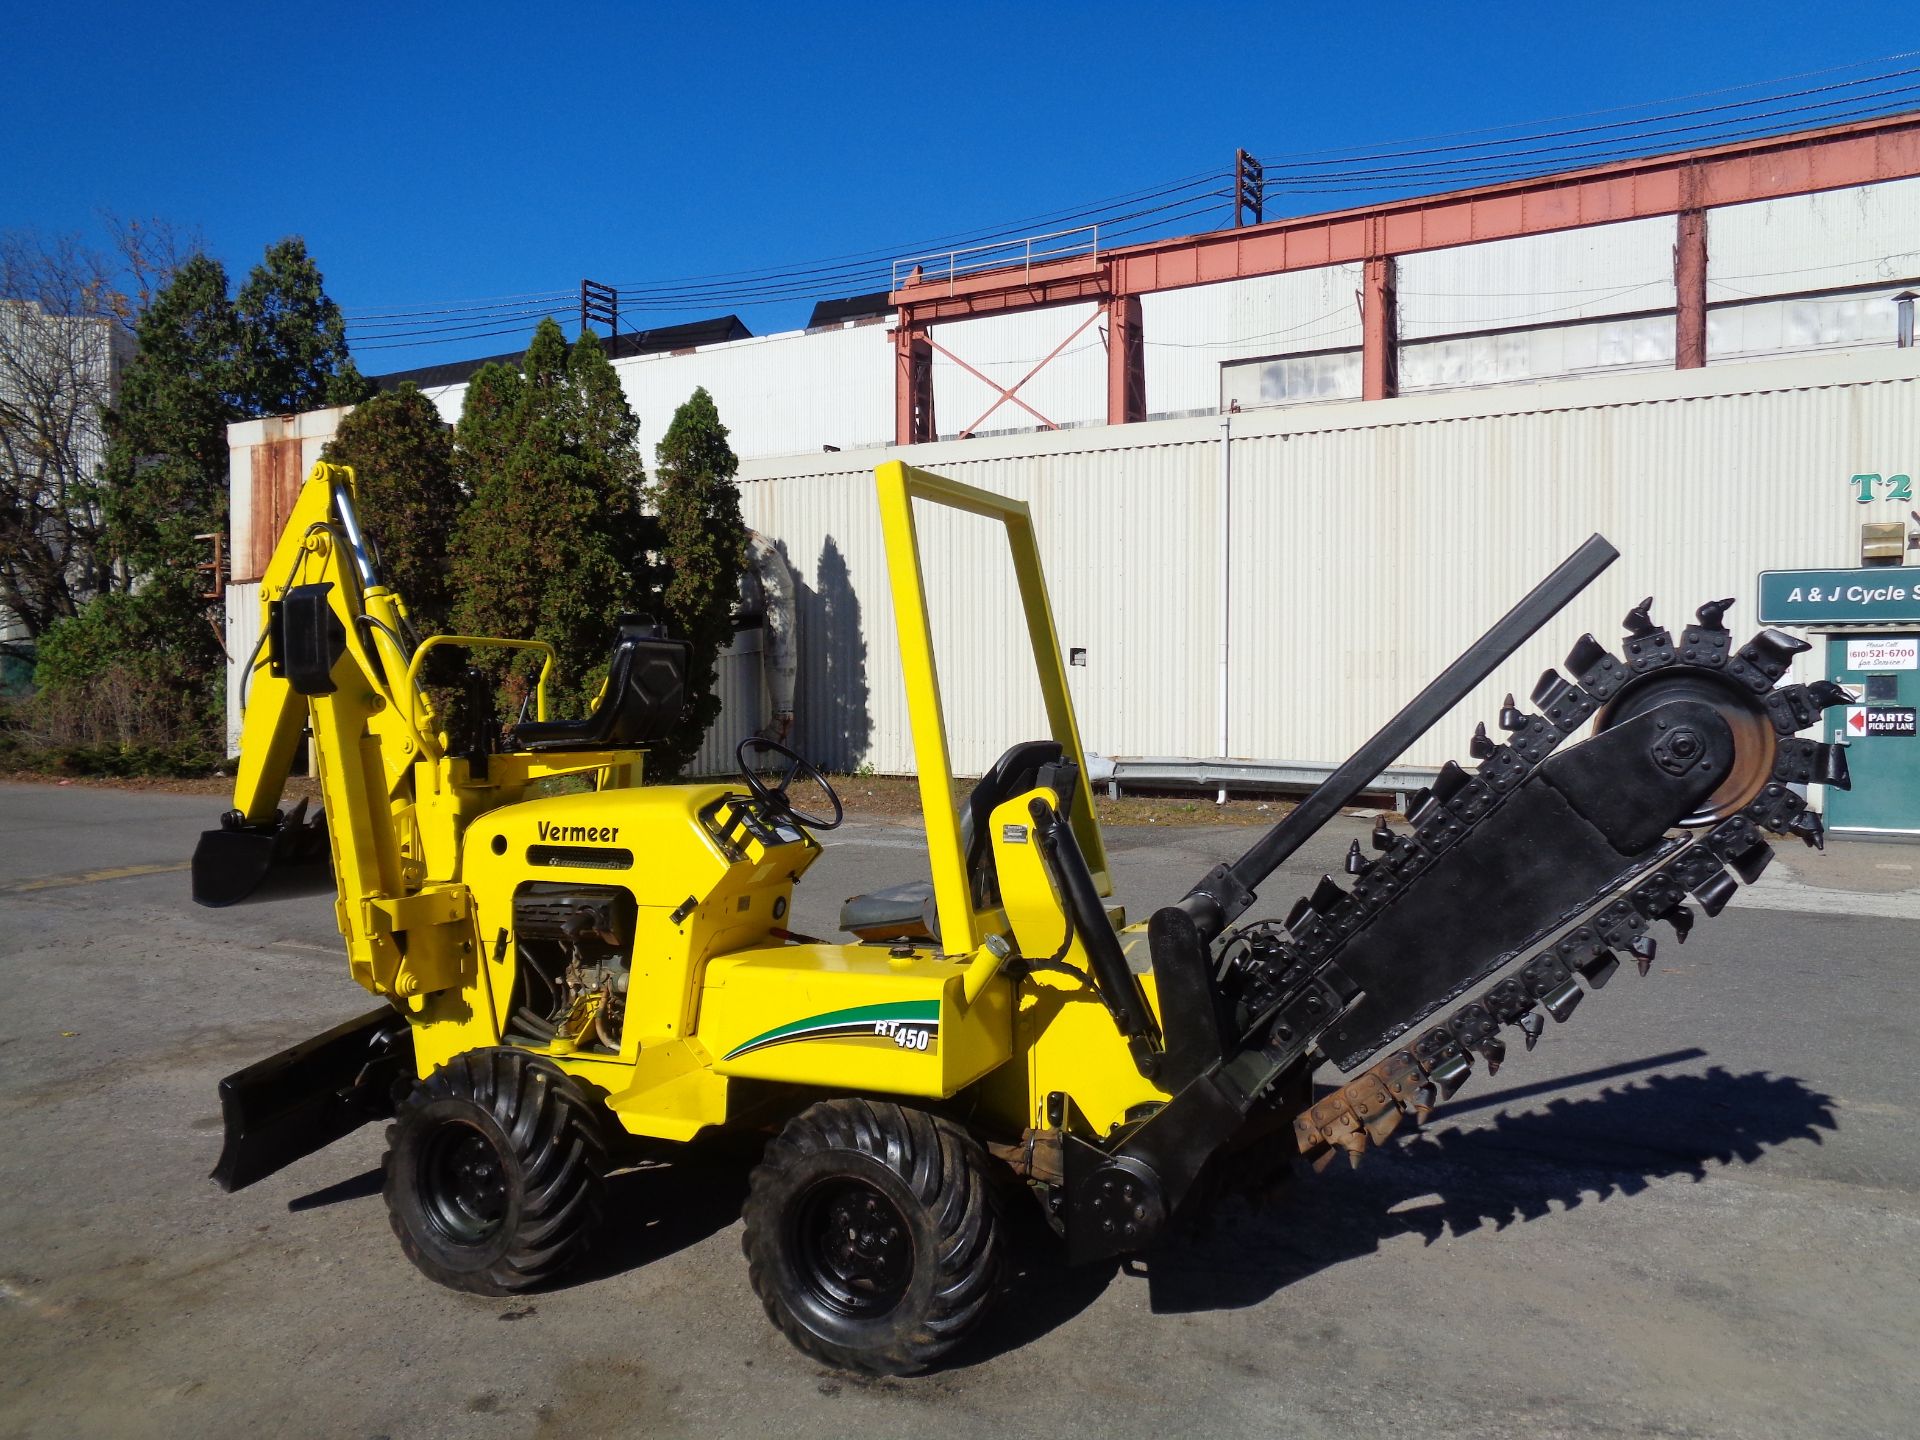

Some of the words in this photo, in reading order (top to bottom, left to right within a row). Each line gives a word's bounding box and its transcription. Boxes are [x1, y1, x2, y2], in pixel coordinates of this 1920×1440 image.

[1850, 473, 1913, 501] T2
[1787, 587, 1803, 602] A
[1807, 587, 1822, 602] &
[1828, 586, 1841, 602] J
[1846, 586, 1906, 605] Cycle
[1868, 713, 1914, 722] PARTS
[1868, 722, 1894, 730] PICK-UP
[1896, 722, 1914, 730] LANE
[537, 820, 620, 843] Vermeer
